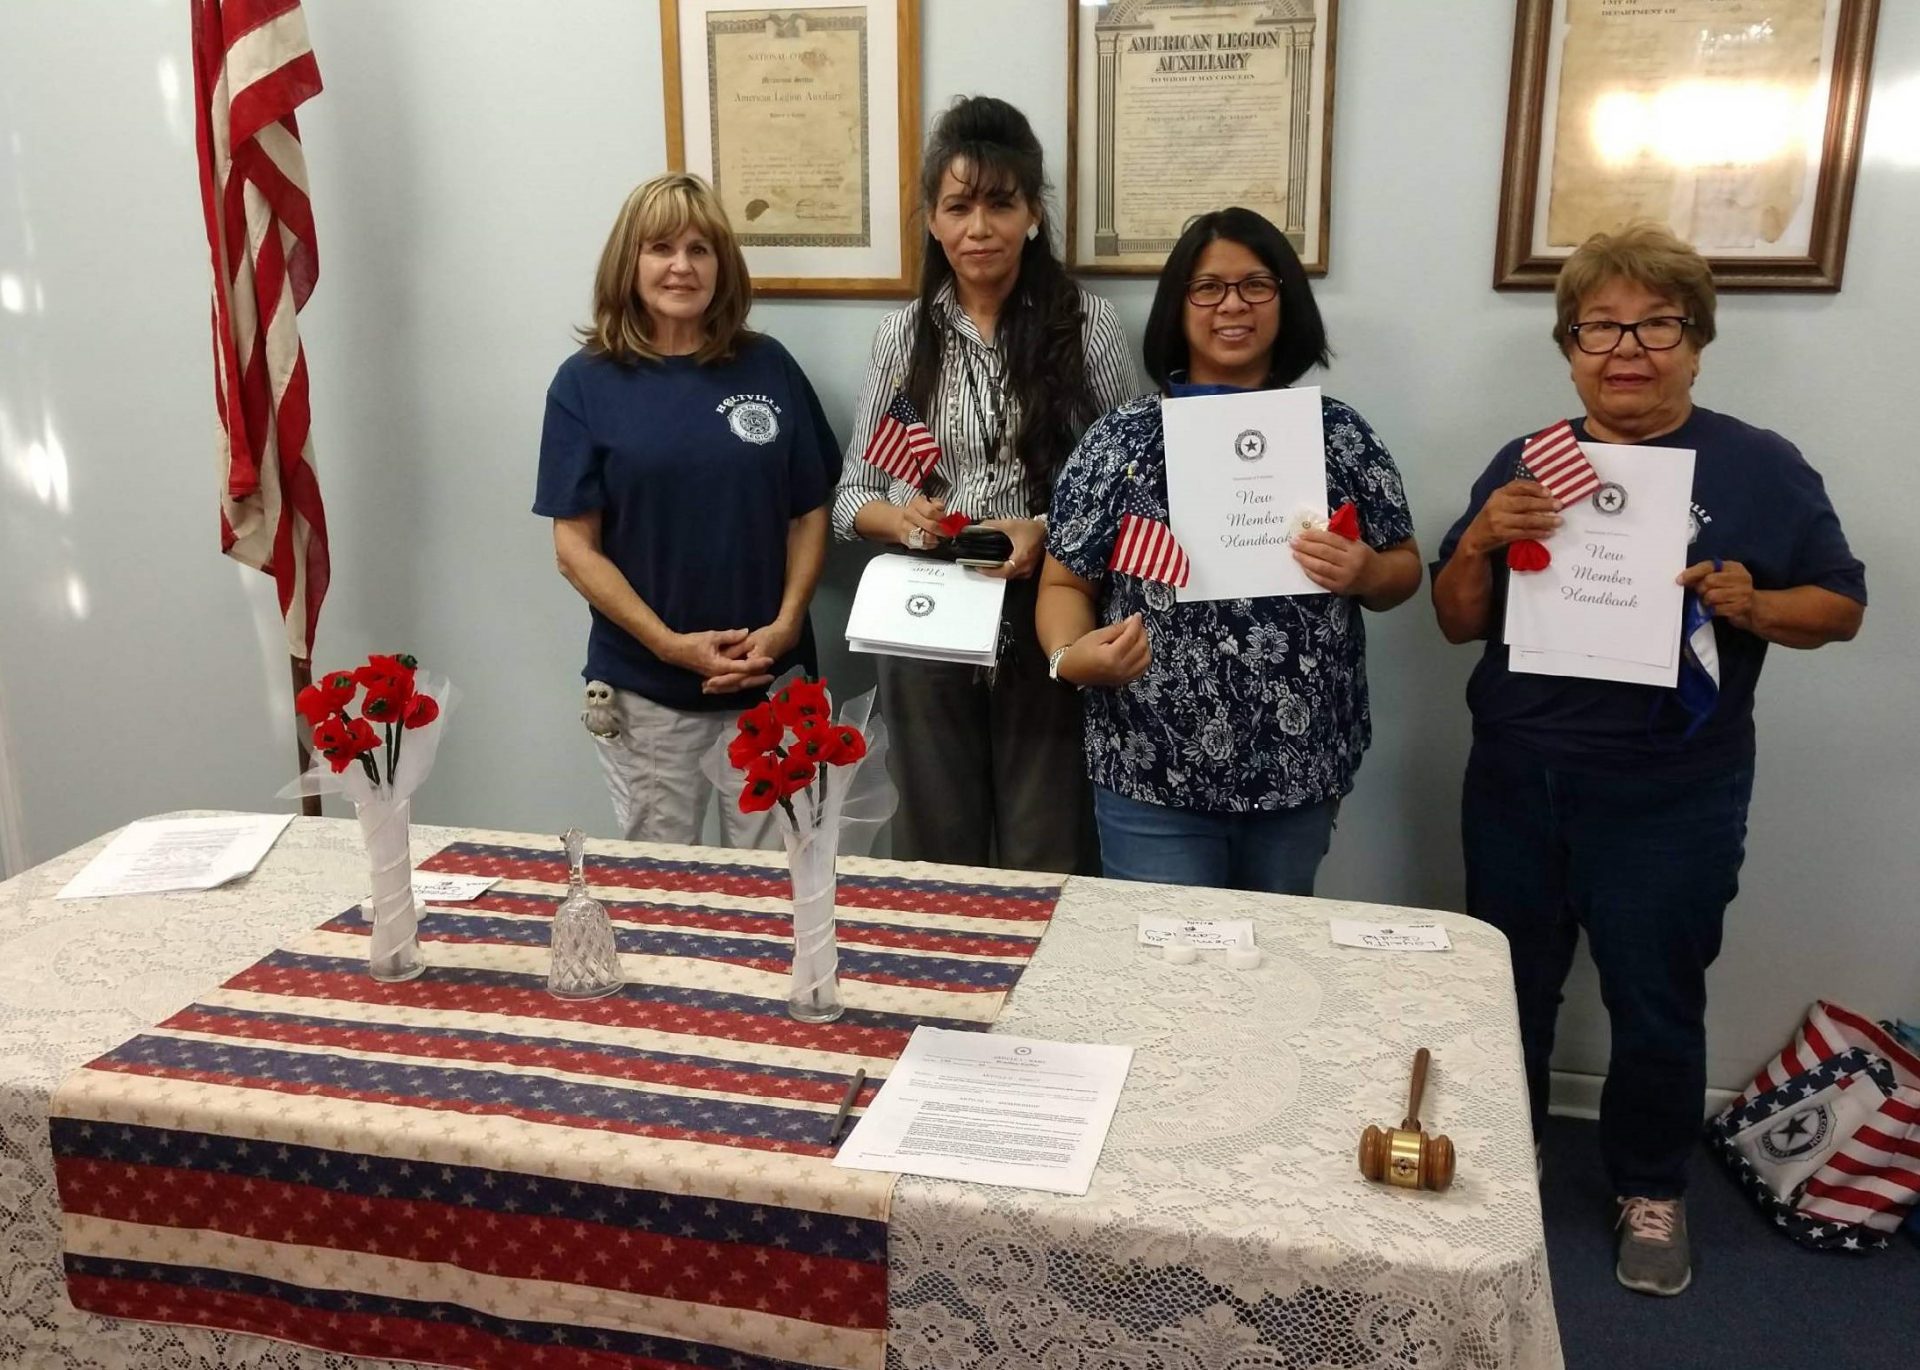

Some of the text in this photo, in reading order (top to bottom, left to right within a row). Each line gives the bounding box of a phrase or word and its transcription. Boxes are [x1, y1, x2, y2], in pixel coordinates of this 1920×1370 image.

[1129, 31, 1280, 52] AMERICAN LEGION
[1155, 53, 1252, 72] AUXILIARY
[1235, 490, 1273, 505] New
[1226, 511, 1285, 527] Member
[1585, 543, 1625, 561] New
[1571, 564, 1633, 585] Member
[1560, 585, 1639, 608] Handbook
